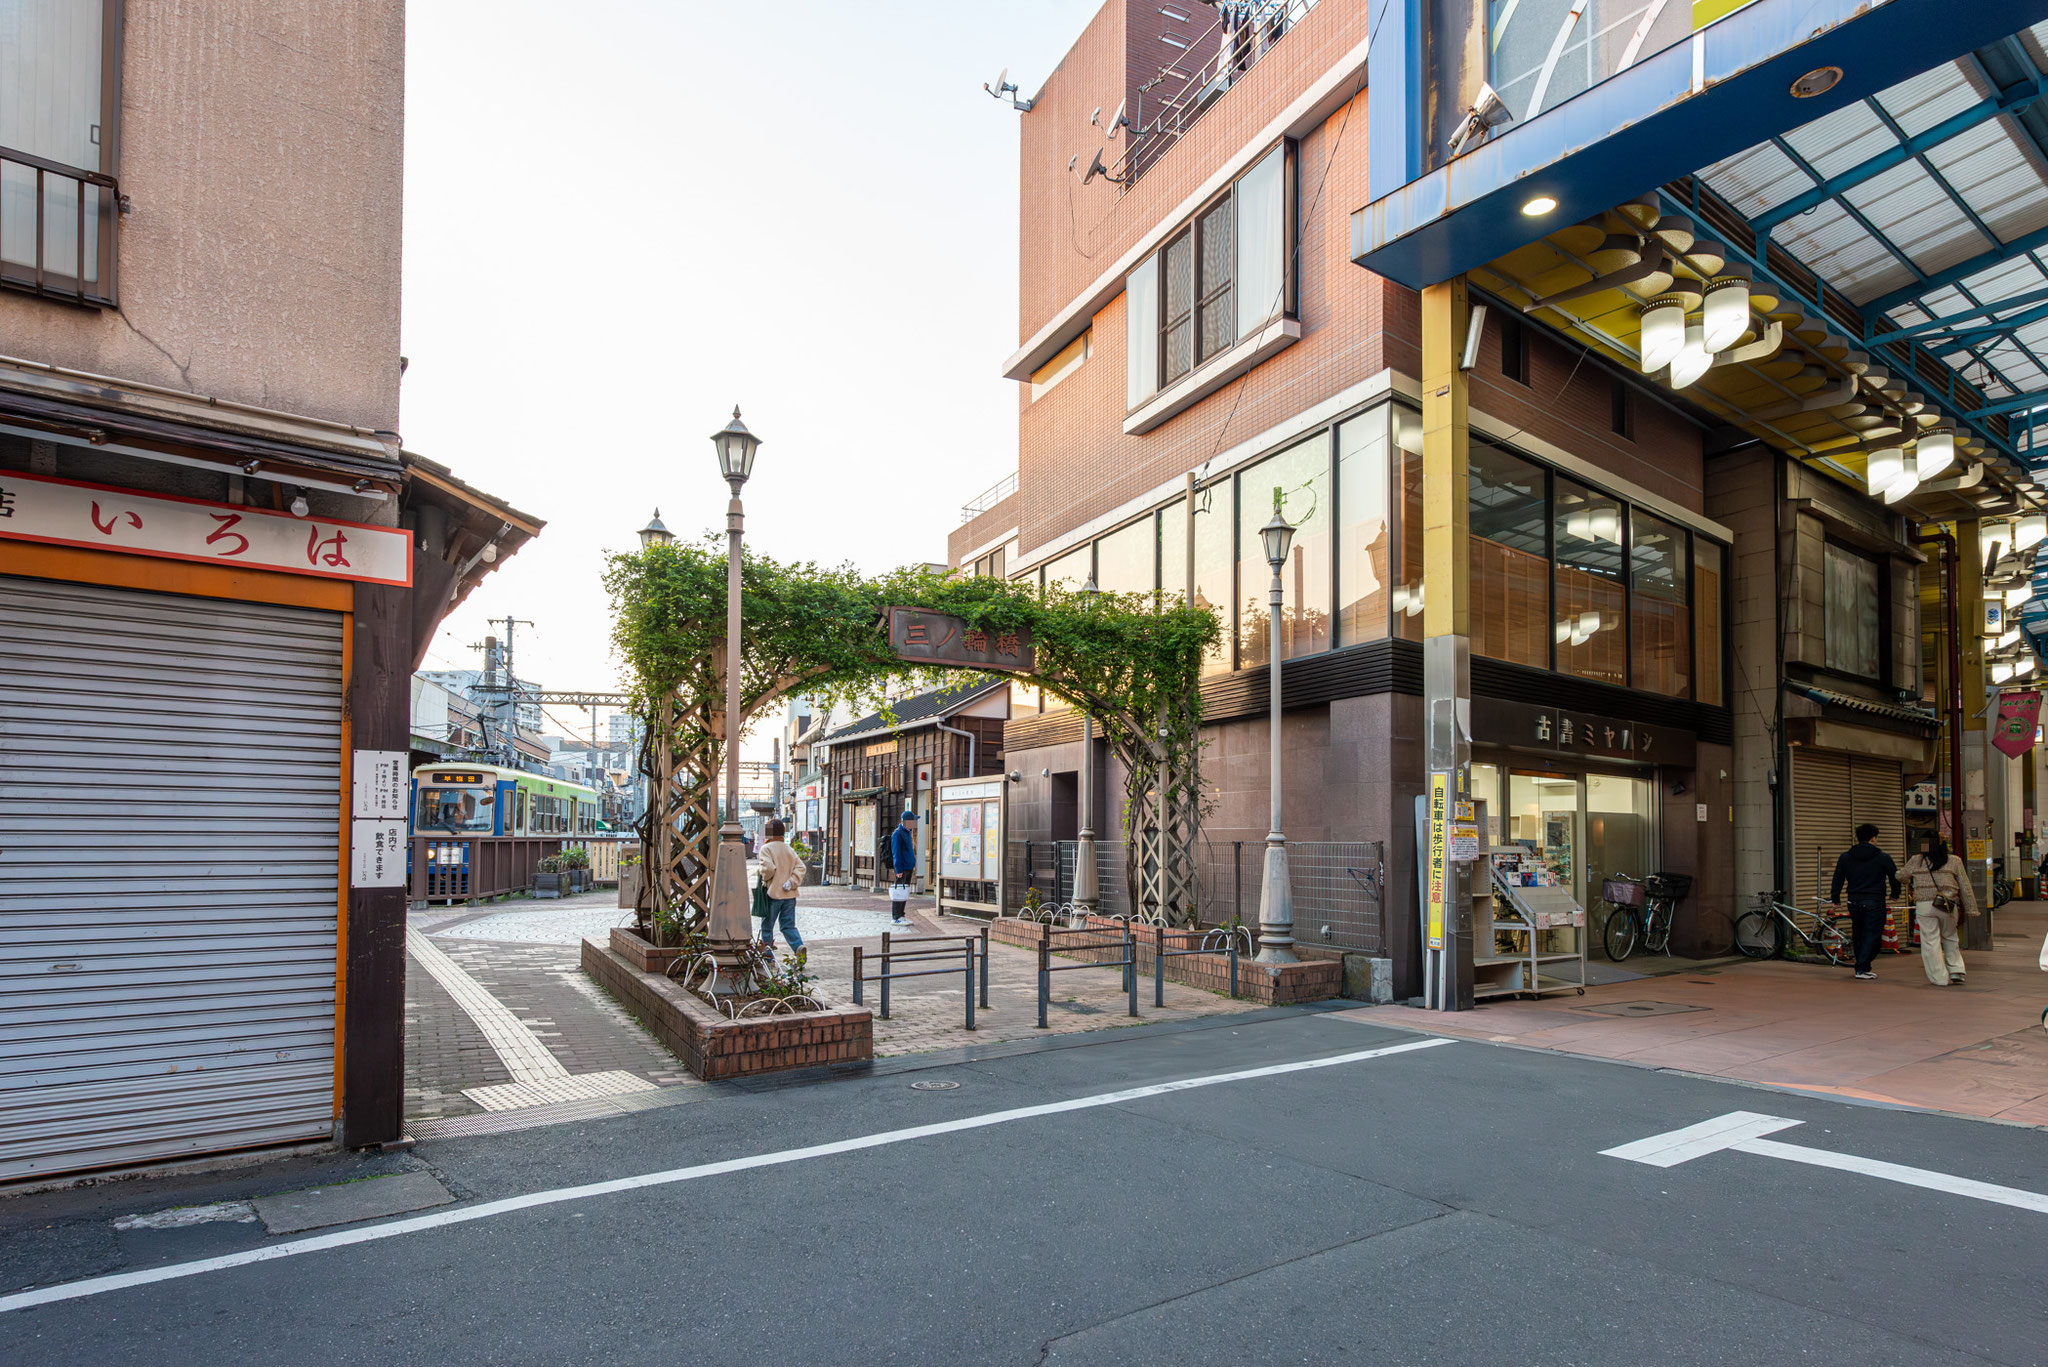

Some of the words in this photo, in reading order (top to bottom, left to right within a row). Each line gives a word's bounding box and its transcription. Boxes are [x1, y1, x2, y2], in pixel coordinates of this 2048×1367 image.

[91, 500, 351, 568] いろは
[905, 625, 1020, 657] 三ノ輪橋
[444, 775, 475, 783] 早稲田
[375, 832, 384, 879] 飲食できます
[388, 828, 397, 852] 店内で
[1431, 787, 1444, 904] 自転車は歩行者に注意
